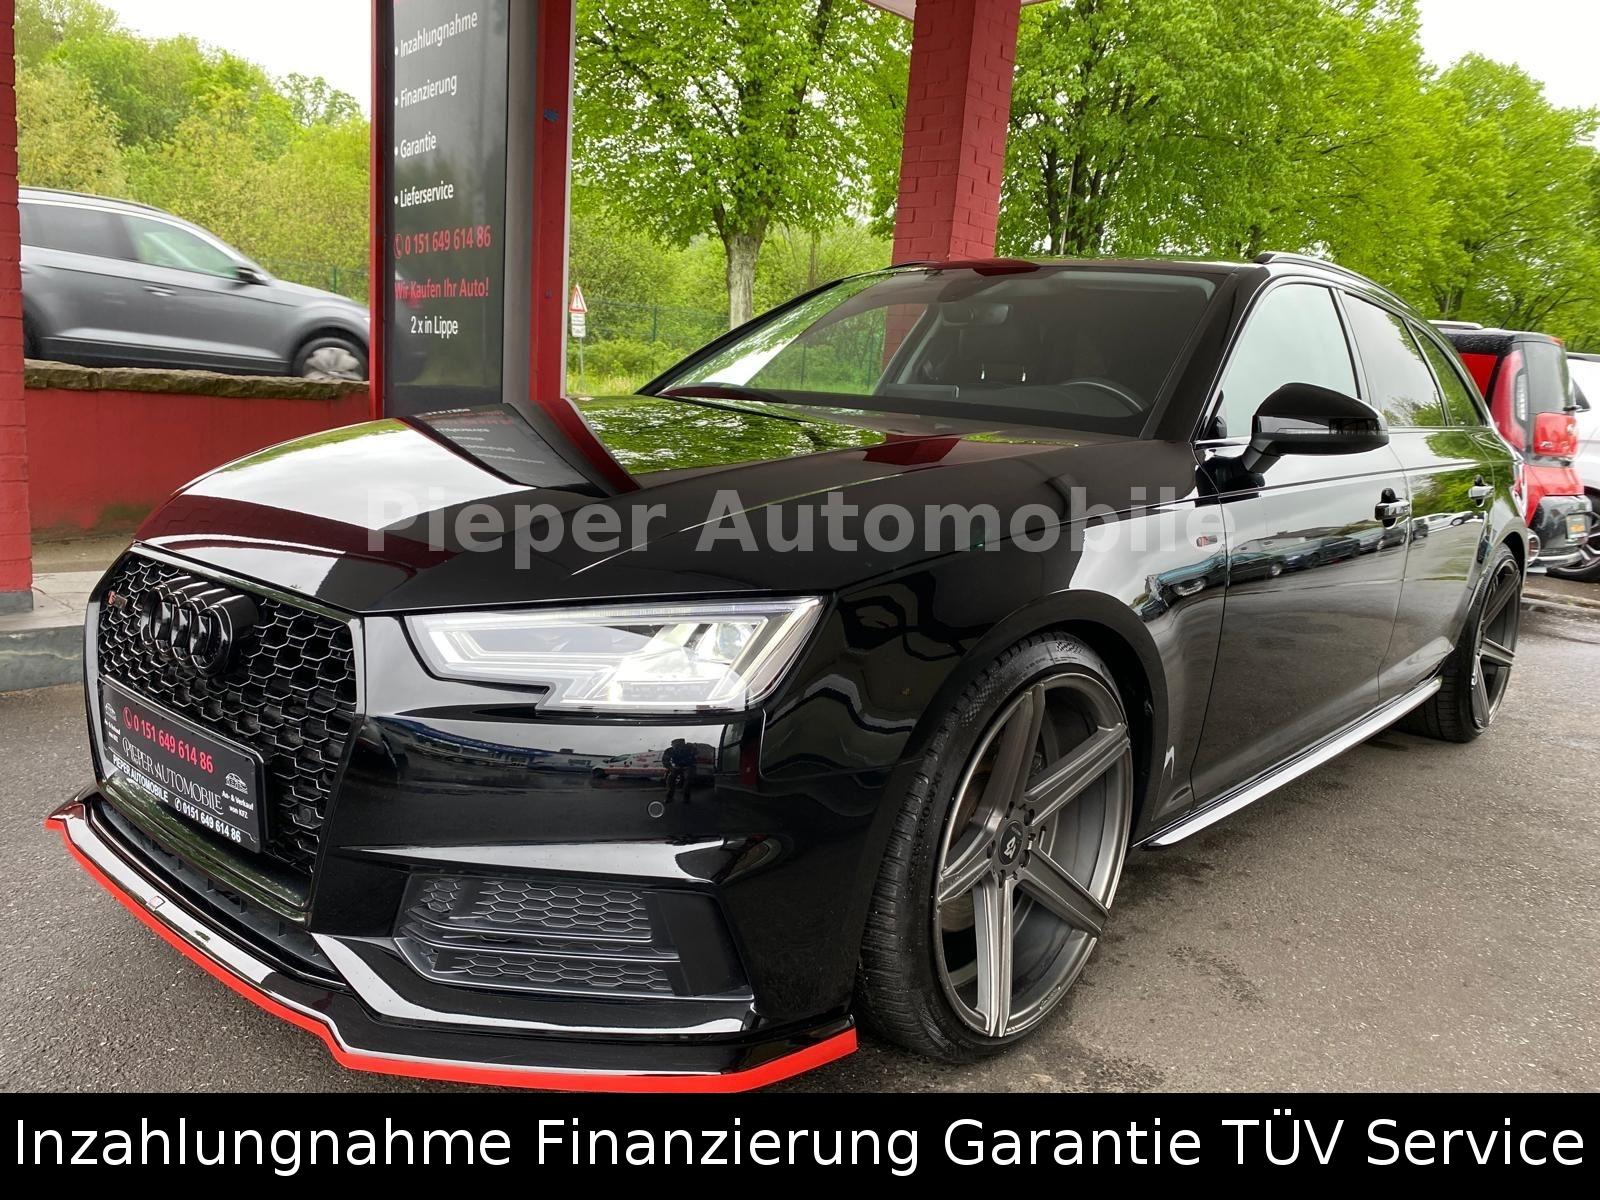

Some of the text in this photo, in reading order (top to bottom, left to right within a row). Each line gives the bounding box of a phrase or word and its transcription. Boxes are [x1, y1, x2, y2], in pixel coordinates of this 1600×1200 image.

[400, 12, 478, 58] Inzahlungnahme
[400, 75, 457, 108] Finanzierung
[400, 131, 437, 158] Garantie
[400, 180, 454, 208] Lieferservice
[404, 225, 491, 255] 0 151 649 614 86
[395, 277, 489, 299] Wir Kaufen Ihr Auto!
[410, 315, 459, 339] 2 x in Lippe
[133, 714, 139, 732] 0
[141, 720, 156, 743] 151
[158, 730, 176, 754] 649
[178, 740, 198, 766] 614
[200, 752, 213, 774] 86
[154, 762, 224, 815] AUTOMOBILE
[183, 802, 242, 843] 0151 649 614 86
